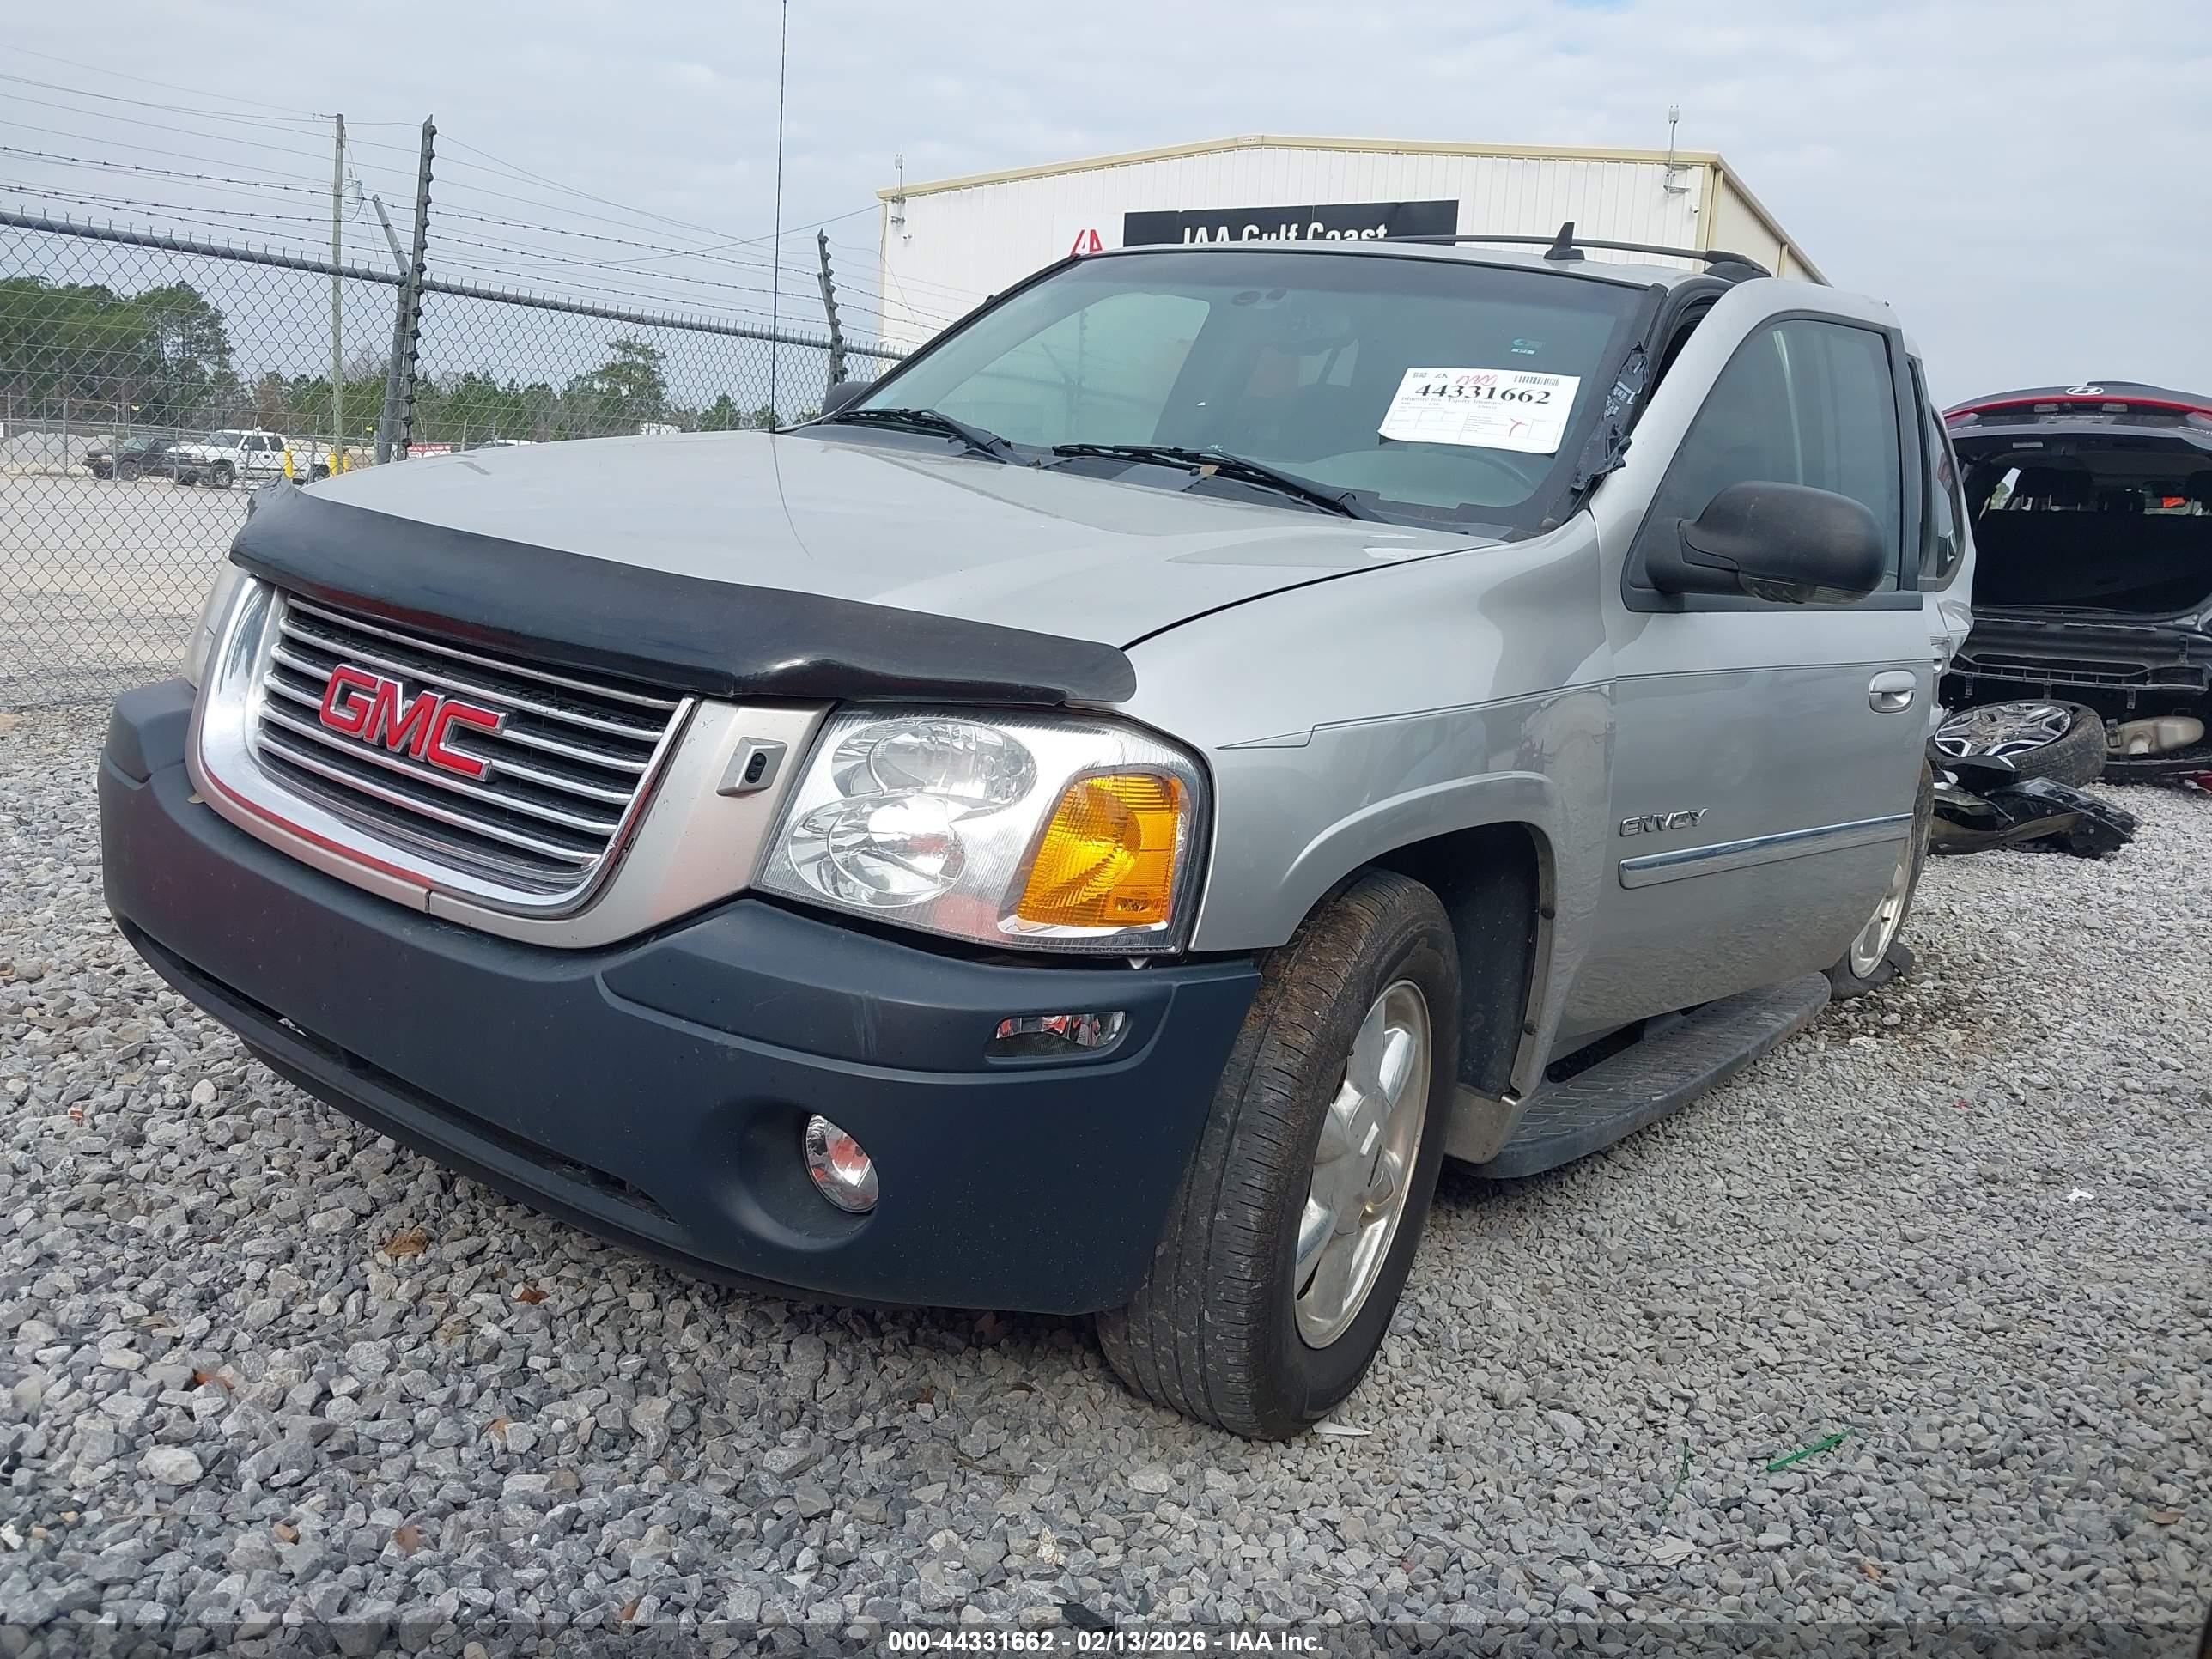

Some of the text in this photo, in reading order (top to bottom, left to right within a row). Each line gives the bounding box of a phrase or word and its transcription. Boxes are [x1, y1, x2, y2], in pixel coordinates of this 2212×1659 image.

[1414, 383, 1552, 405] 44331662
[319, 663, 508, 782] GMC
[1620, 807, 1709, 837] ENVOY
